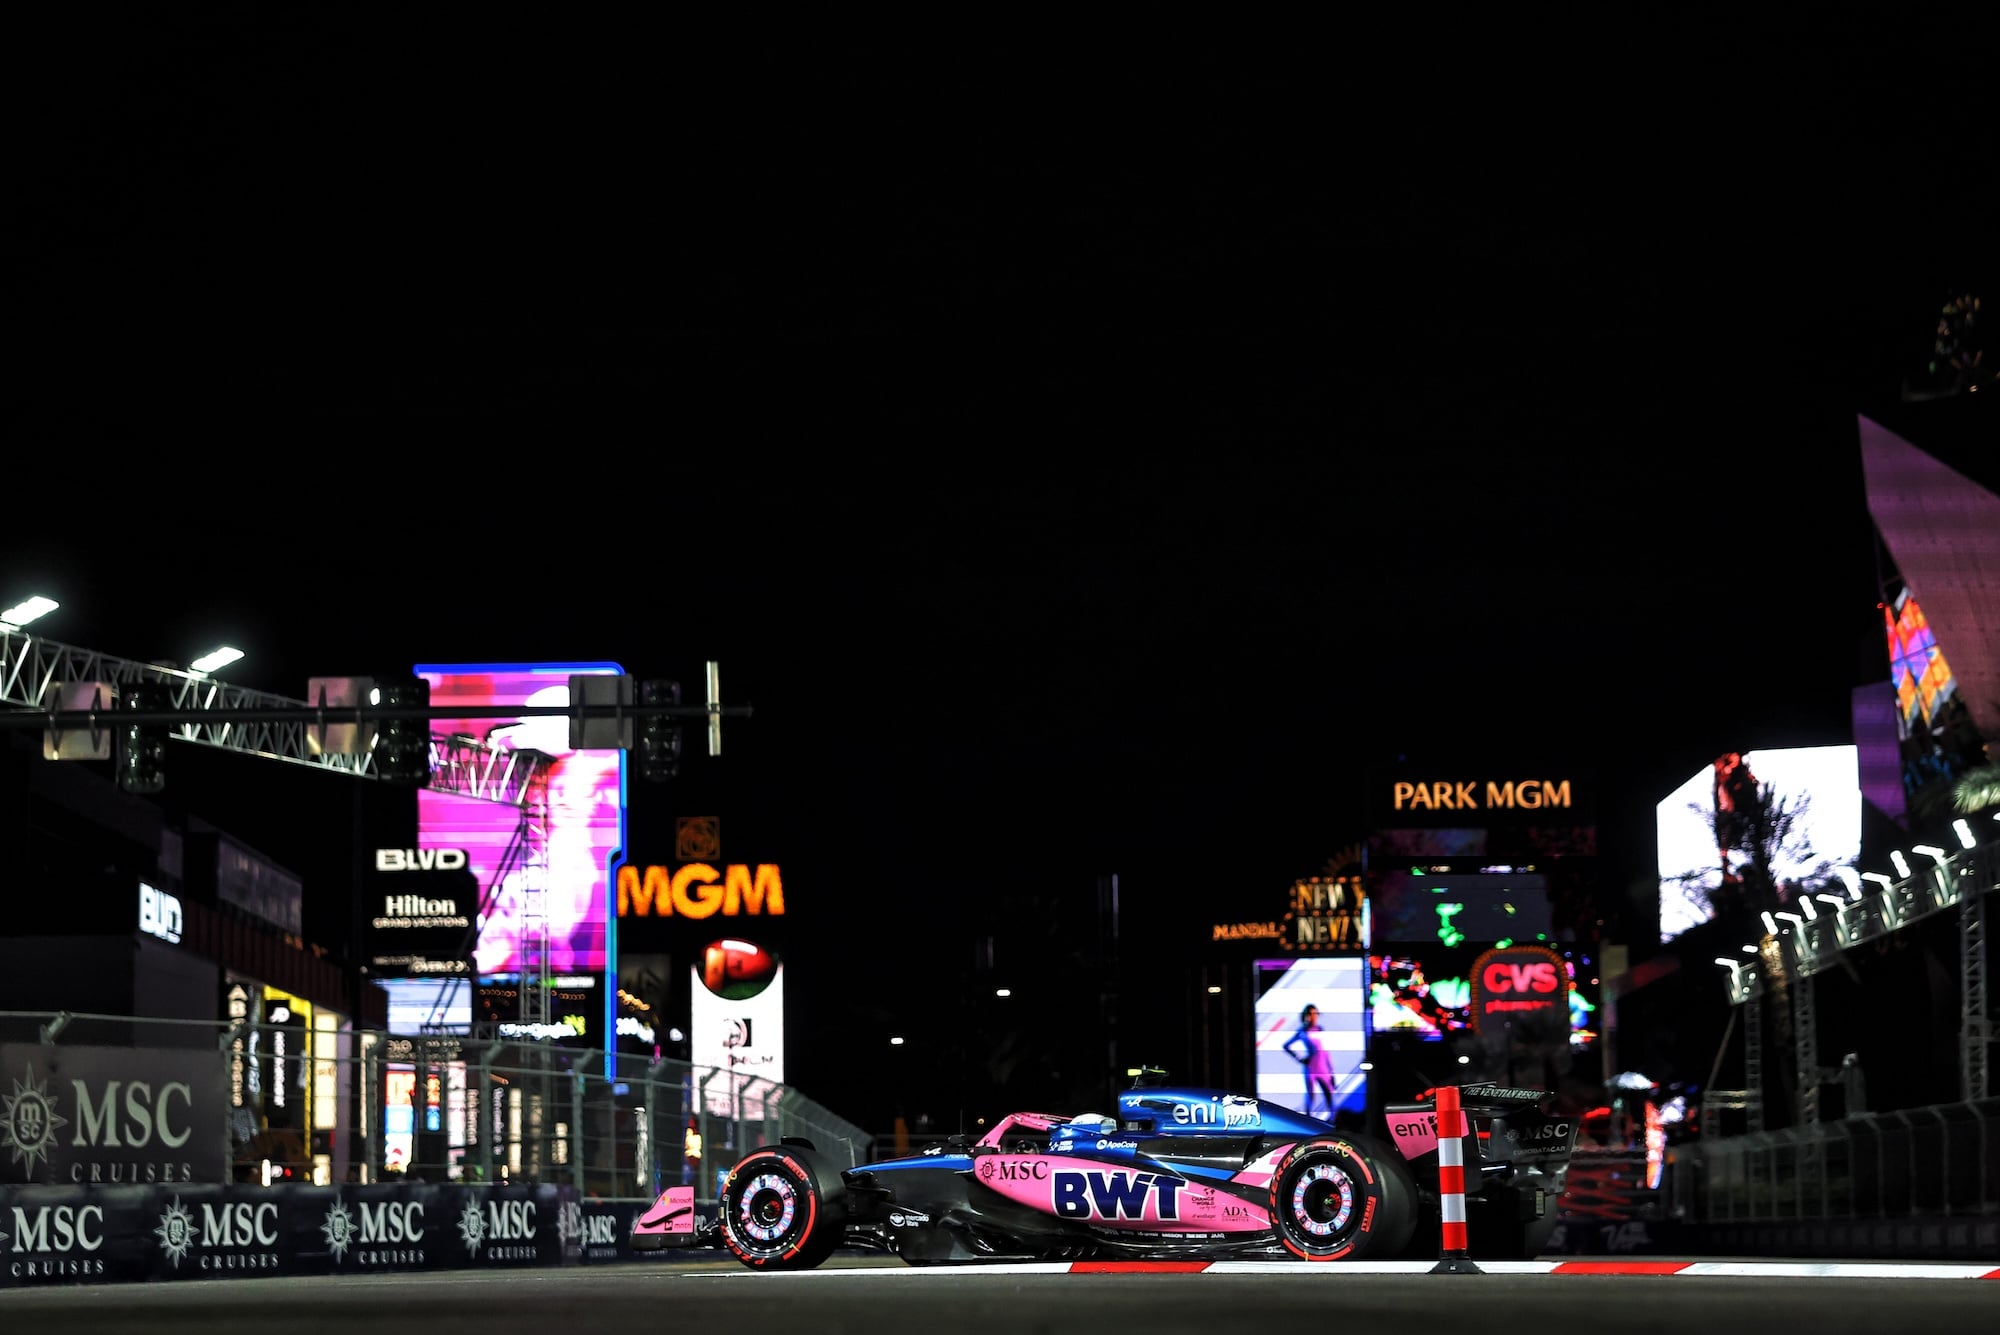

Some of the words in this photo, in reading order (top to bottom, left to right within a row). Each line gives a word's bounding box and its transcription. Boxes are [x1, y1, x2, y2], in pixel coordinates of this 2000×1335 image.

[1394, 781, 1478, 810] PARK
[1486, 780, 1572, 809] MGM
[376, 848, 466, 871] BLVD
[616, 863, 785, 919] MGM
[1297, 882, 1345, 911] NEW
[385, 895, 457, 917] Hilton
[1297, 916, 1350, 943] NEW
[1483, 962, 1558, 993] CVS
[1464, 1086, 1482, 1096] THE
[1480, 1087, 1519, 1098] VENETIAN
[1515, 1090, 1545, 1100] RESORT
[71, 1079, 192, 1148] MSC
[1172, 1096, 1218, 1125] eni
[1395, 1118, 1428, 1137] eni
[1523, 1123, 1569, 1141] MSC
[1107, 1140, 1138, 1150] ApeCoin
[71, 1162, 192, 1183] CRUISES
[998, 1161, 1048, 1180] MSC
[1053, 1171, 1188, 1220] BWT
[359, 1201, 425, 1243] MSC
[489, 1199, 537, 1240] MSC
[1222, 1206, 1249, 1217] ADA
[12, 1205, 104, 1252] MSC
[201, 1203, 279, 1247] MSC
[590, 1215, 617, 1244] MSC
[201, 1253, 279, 1270] CRUISES
[358, 1250, 425, 1265] CRUISES
[488, 1246, 537, 1260] CRUISES
[11, 1259, 104, 1278] CRUISES
